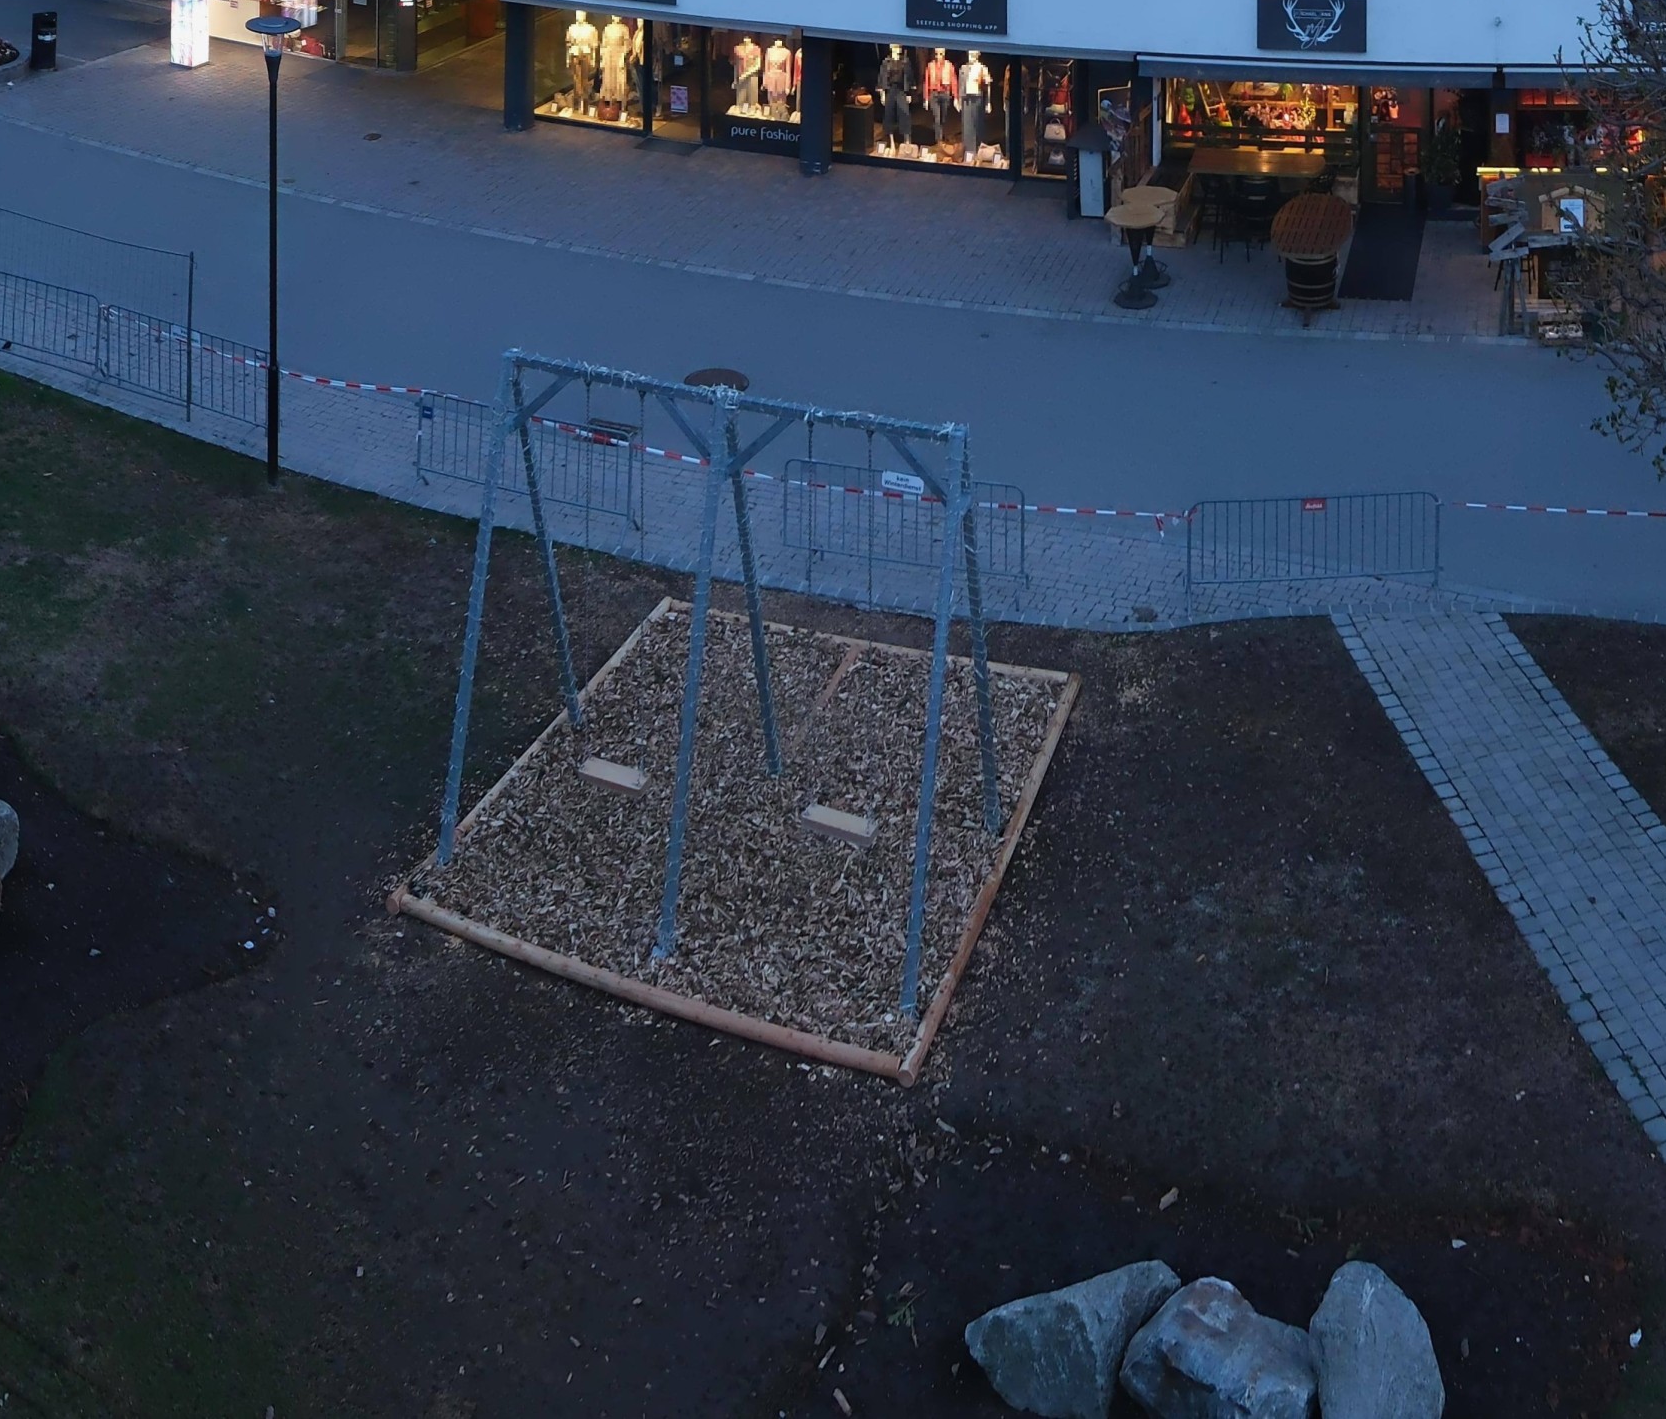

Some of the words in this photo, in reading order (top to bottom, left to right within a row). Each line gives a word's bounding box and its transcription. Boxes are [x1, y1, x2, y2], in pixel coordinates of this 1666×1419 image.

[943, 3, 972, 11] SEEFELD
[916, 19, 944, 27] SEEFELD
[730, 126, 757, 137] pure
